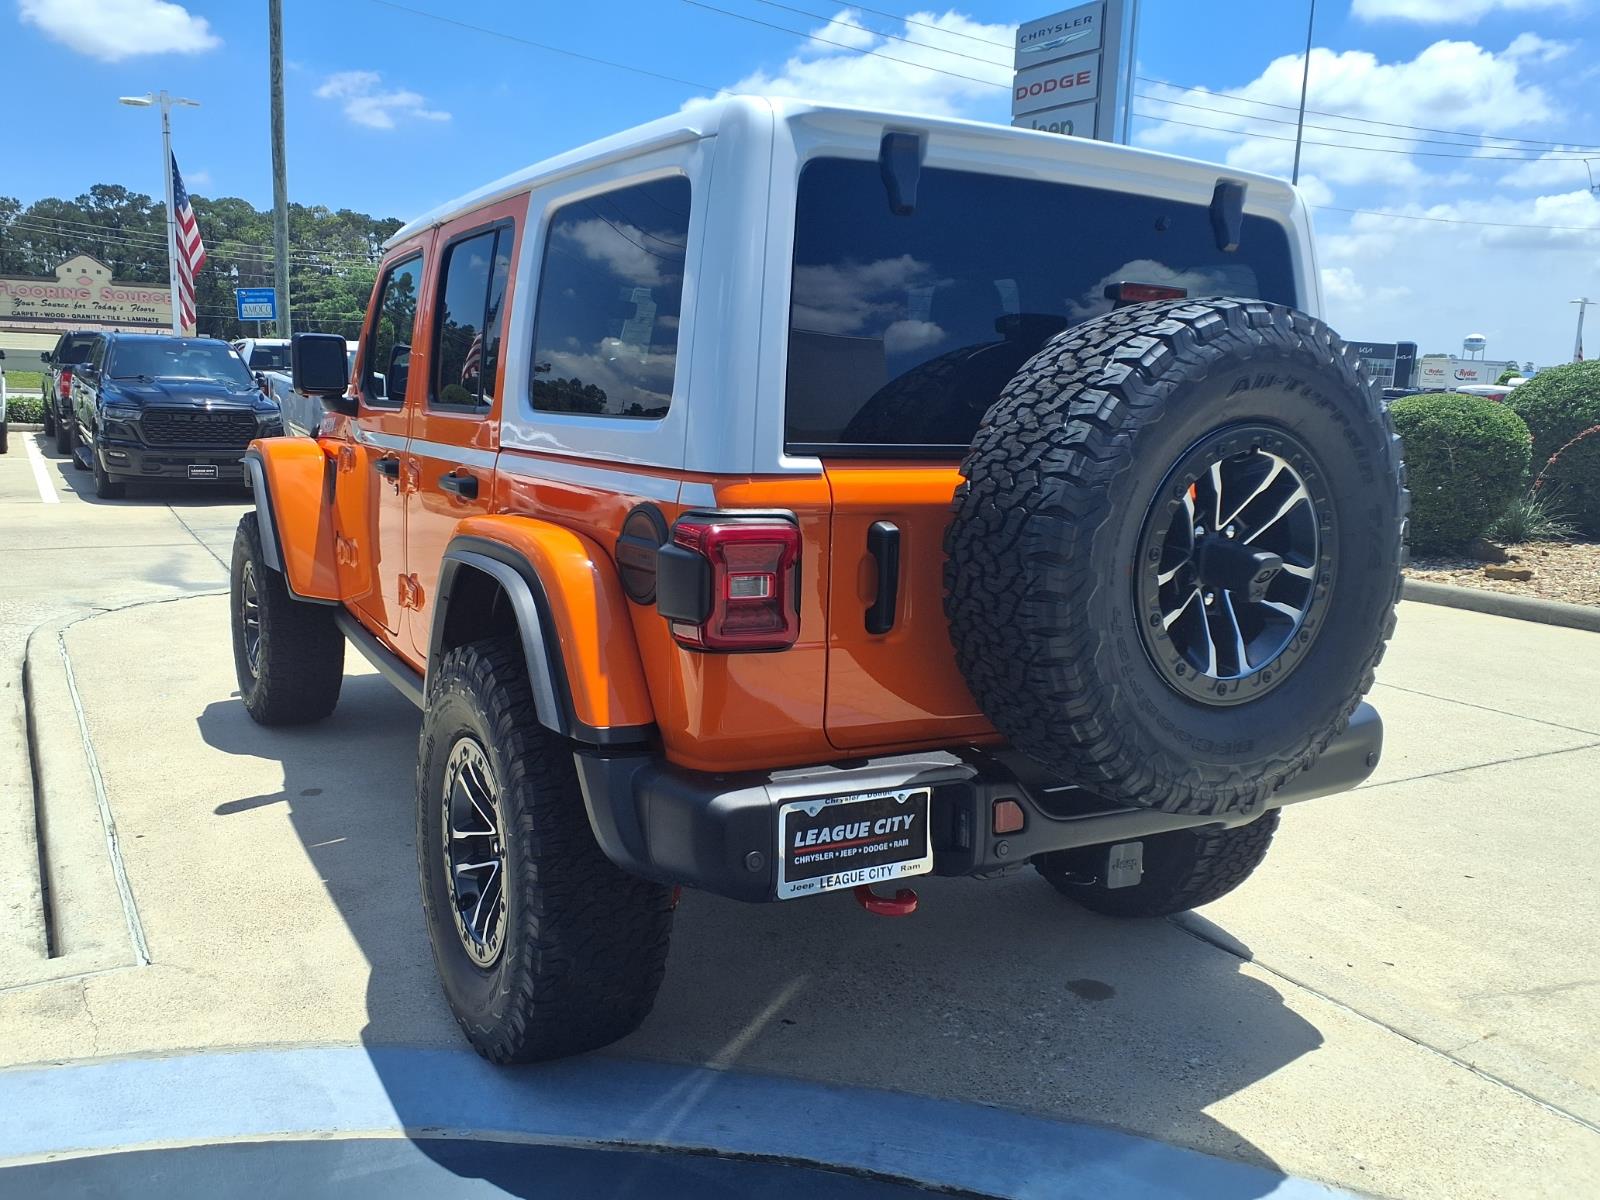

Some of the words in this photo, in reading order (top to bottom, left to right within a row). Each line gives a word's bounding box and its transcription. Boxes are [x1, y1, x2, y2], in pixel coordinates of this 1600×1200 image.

[1020, 15, 1093, 43] CHRYSLER
[1016, 70, 1091, 100] DODGE
[13, 298, 35, 307] Your
[41, 299, 69, 308] Source
[74, 301, 86, 310] for
[92, 301, 124, 312] Today's
[131, 304, 156, 313] Floors
[100, 287, 171, 304] SOURCE
[1459, 368, 1478, 377] Ryder
[794, 820, 871, 848] LEAGUE
[874, 813, 915, 835] CITY
[794, 851, 834, 865] CHRYSLER
[840, 848, 857, 858] JEEP
[863, 844, 888, 854] DODGE
[893, 839, 909, 848] RAM
[790, 881, 815, 892] Jeep
[820, 868, 865, 889] LEAGUE
[868, 865, 894, 879] CITY
[900, 863, 921, 872] Ram
